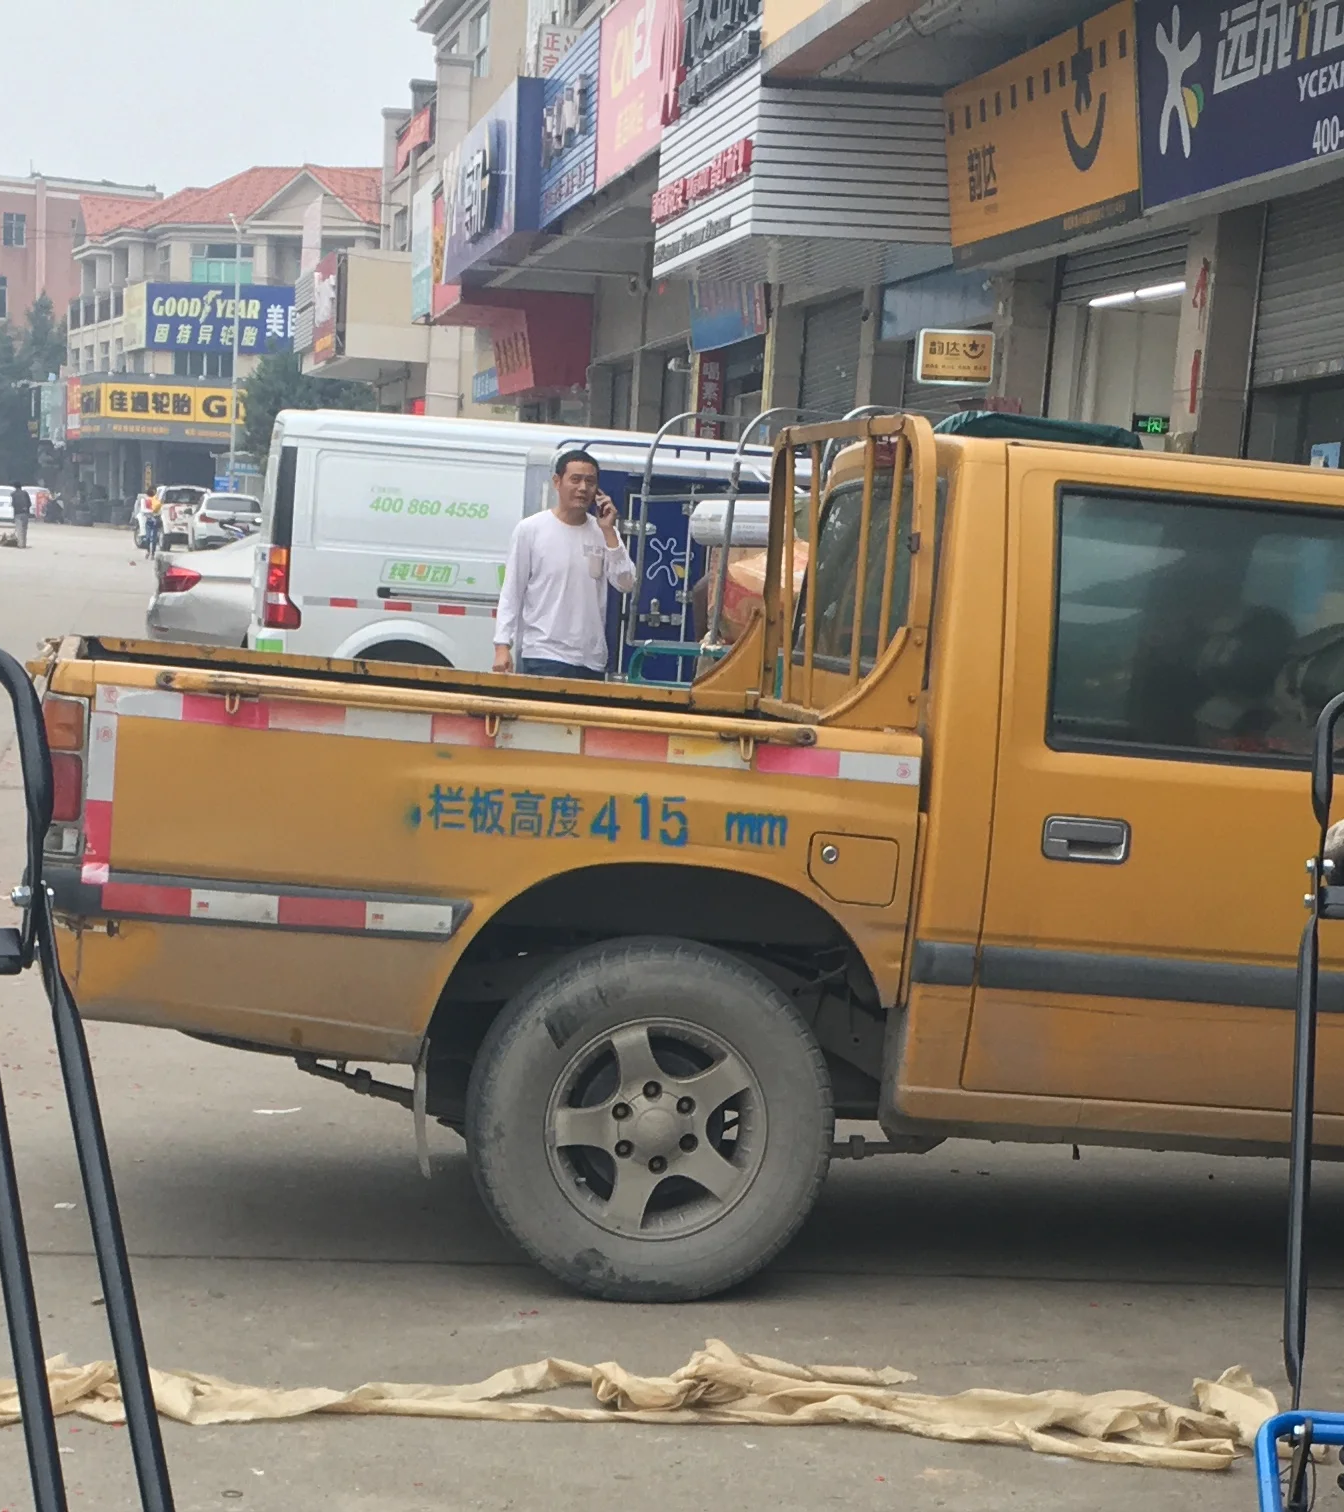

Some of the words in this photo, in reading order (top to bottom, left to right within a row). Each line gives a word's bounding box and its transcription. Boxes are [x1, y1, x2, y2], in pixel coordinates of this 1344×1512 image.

[967, 142, 998, 202] 韵达
[154, 323, 259, 347] 固特异轮胎
[369, 496, 404, 513] 400
[407, 498, 442, 516] 860
[445, 501, 490, 519] 4558
[388, 561, 453, 584] 纯电动
[724, 811, 787, 847] mm
